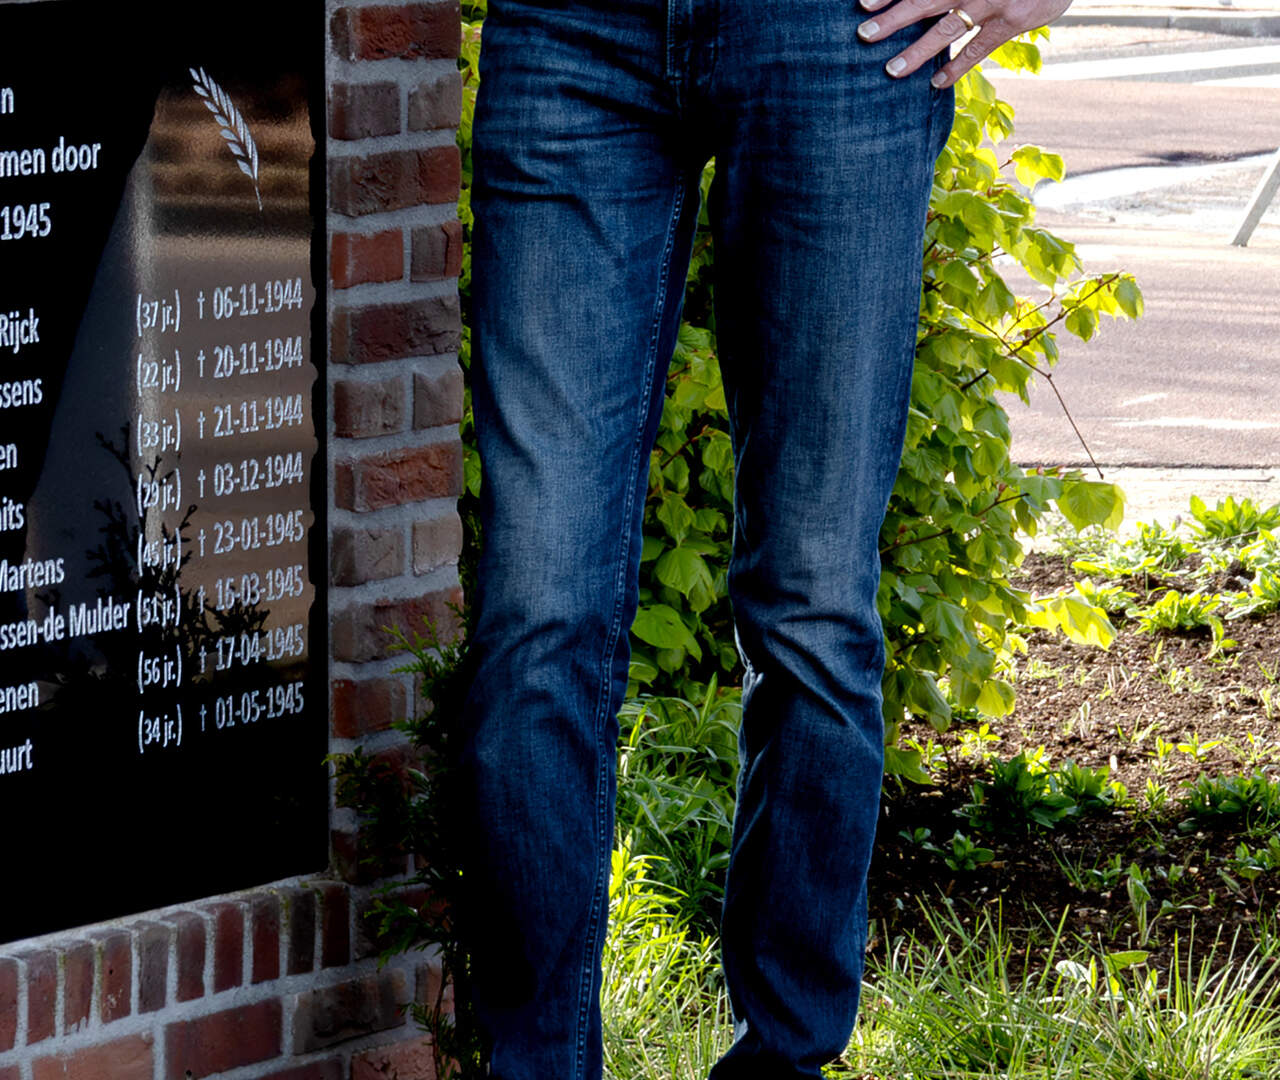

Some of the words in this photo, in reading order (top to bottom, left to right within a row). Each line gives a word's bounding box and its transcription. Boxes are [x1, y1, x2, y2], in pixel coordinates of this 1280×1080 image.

[51, 135, 102, 174] door
[0, 201, 52, 241] 1945
[136, 293, 159, 337] (37
[161, 289, 181, 333] jr.)
[213, 277, 303, 320] 06-11-1944
[137, 353, 159, 397] (22
[161, 349, 181, 393] jr.)
[213, 336, 304, 379] 20-11-1944
[137, 413, 160, 457] (33
[161, 409, 181, 452] jr.)
[213, 394, 304, 437] 21-11-1944
[136, 473, 160, 518] (29
[161, 468, 182, 512] jr.)
[213, 451, 304, 497] 03-12-1944
[162, 527, 182, 571] jr.)
[213, 509, 304, 554] 23-01-1945
[68, 595, 131, 638] Mulder
[162, 584, 182, 627] jr.)
[136, 650, 161, 695] (56
[162, 644, 183, 689] jr.)
[214, 623, 304, 671] 17-04-1945
[137, 709, 161, 754] (34
[162, 703, 183, 748] jr.)
[215, 681, 305, 730] 01-05-1945
